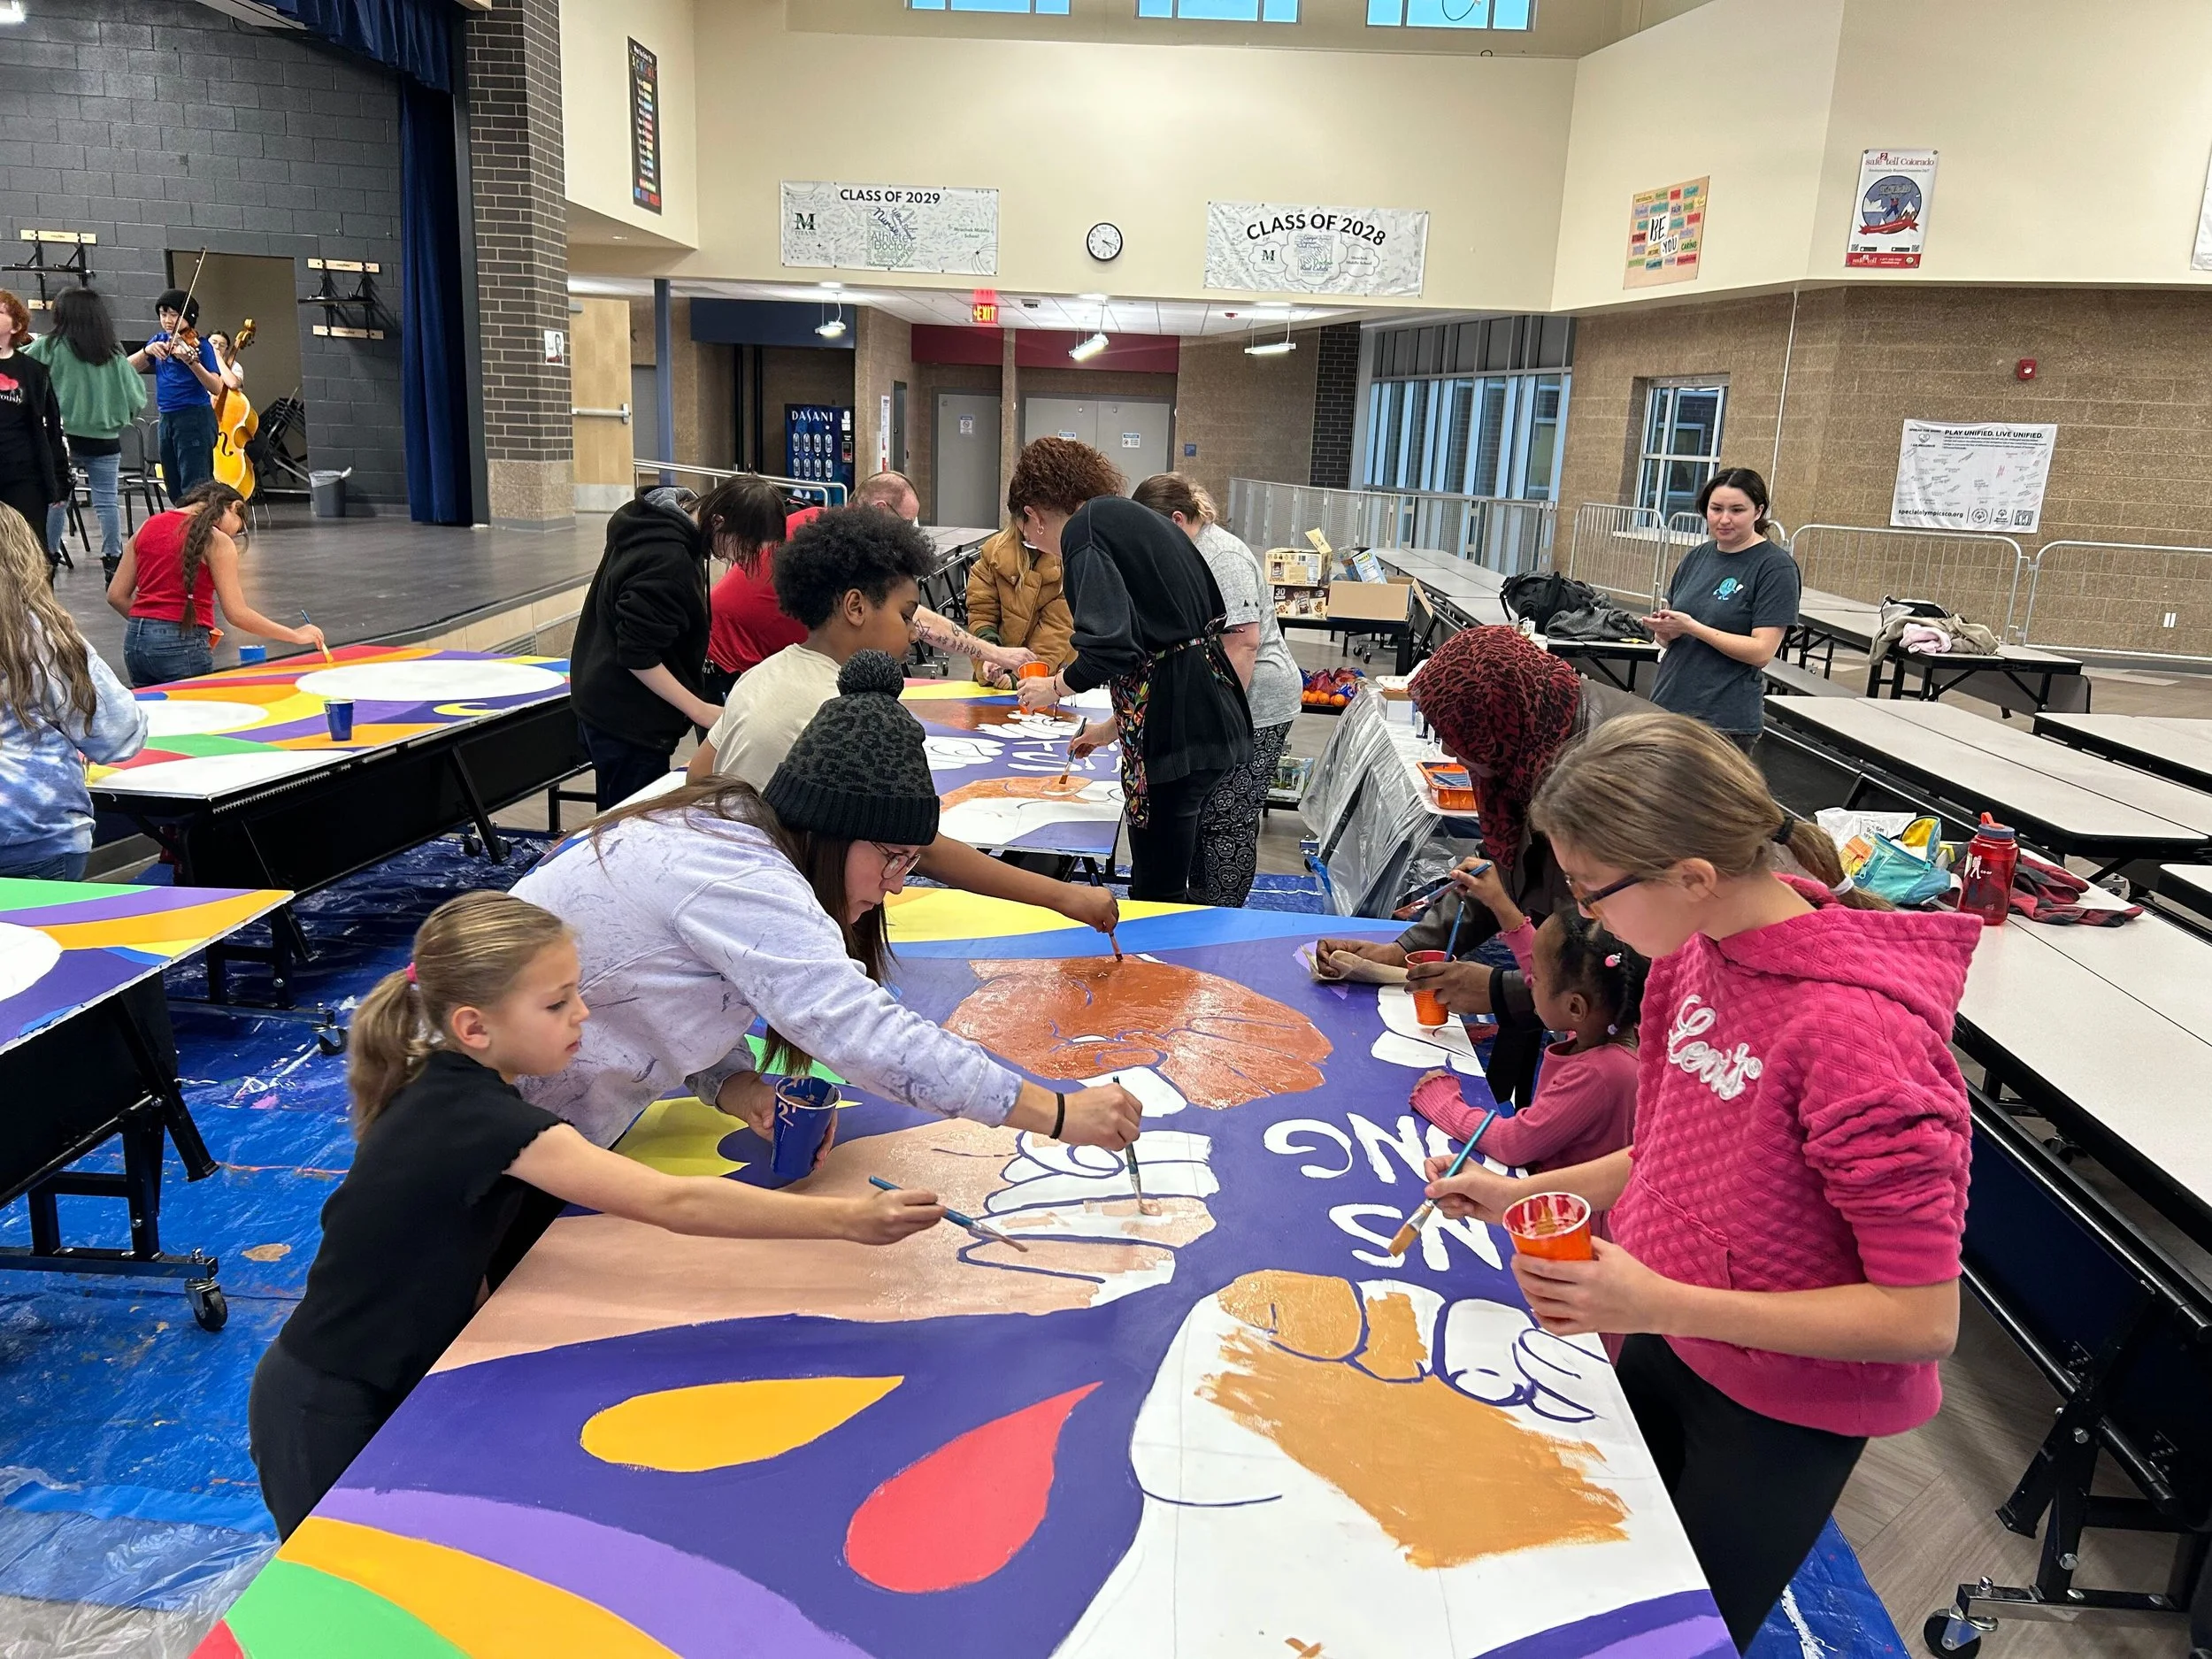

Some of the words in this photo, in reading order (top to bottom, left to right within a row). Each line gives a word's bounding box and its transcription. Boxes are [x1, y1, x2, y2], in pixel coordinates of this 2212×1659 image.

[840, 188, 881, 202] CLASS
[885, 190, 902, 203] OF
[906, 191, 941, 204] 2029
[795, 212, 816, 230] M
[1649, 216, 1666, 242] BE
[1247, 213, 1306, 240] CLASS
[1310, 213, 1338, 230] OF
[1340, 218, 1386, 246] 2028
[874, 240, 908, 251] Doctor
[1261, 250, 1275, 261] M
[976, 304, 997, 321] EXIT
[792, 409, 833, 423] DASANI
